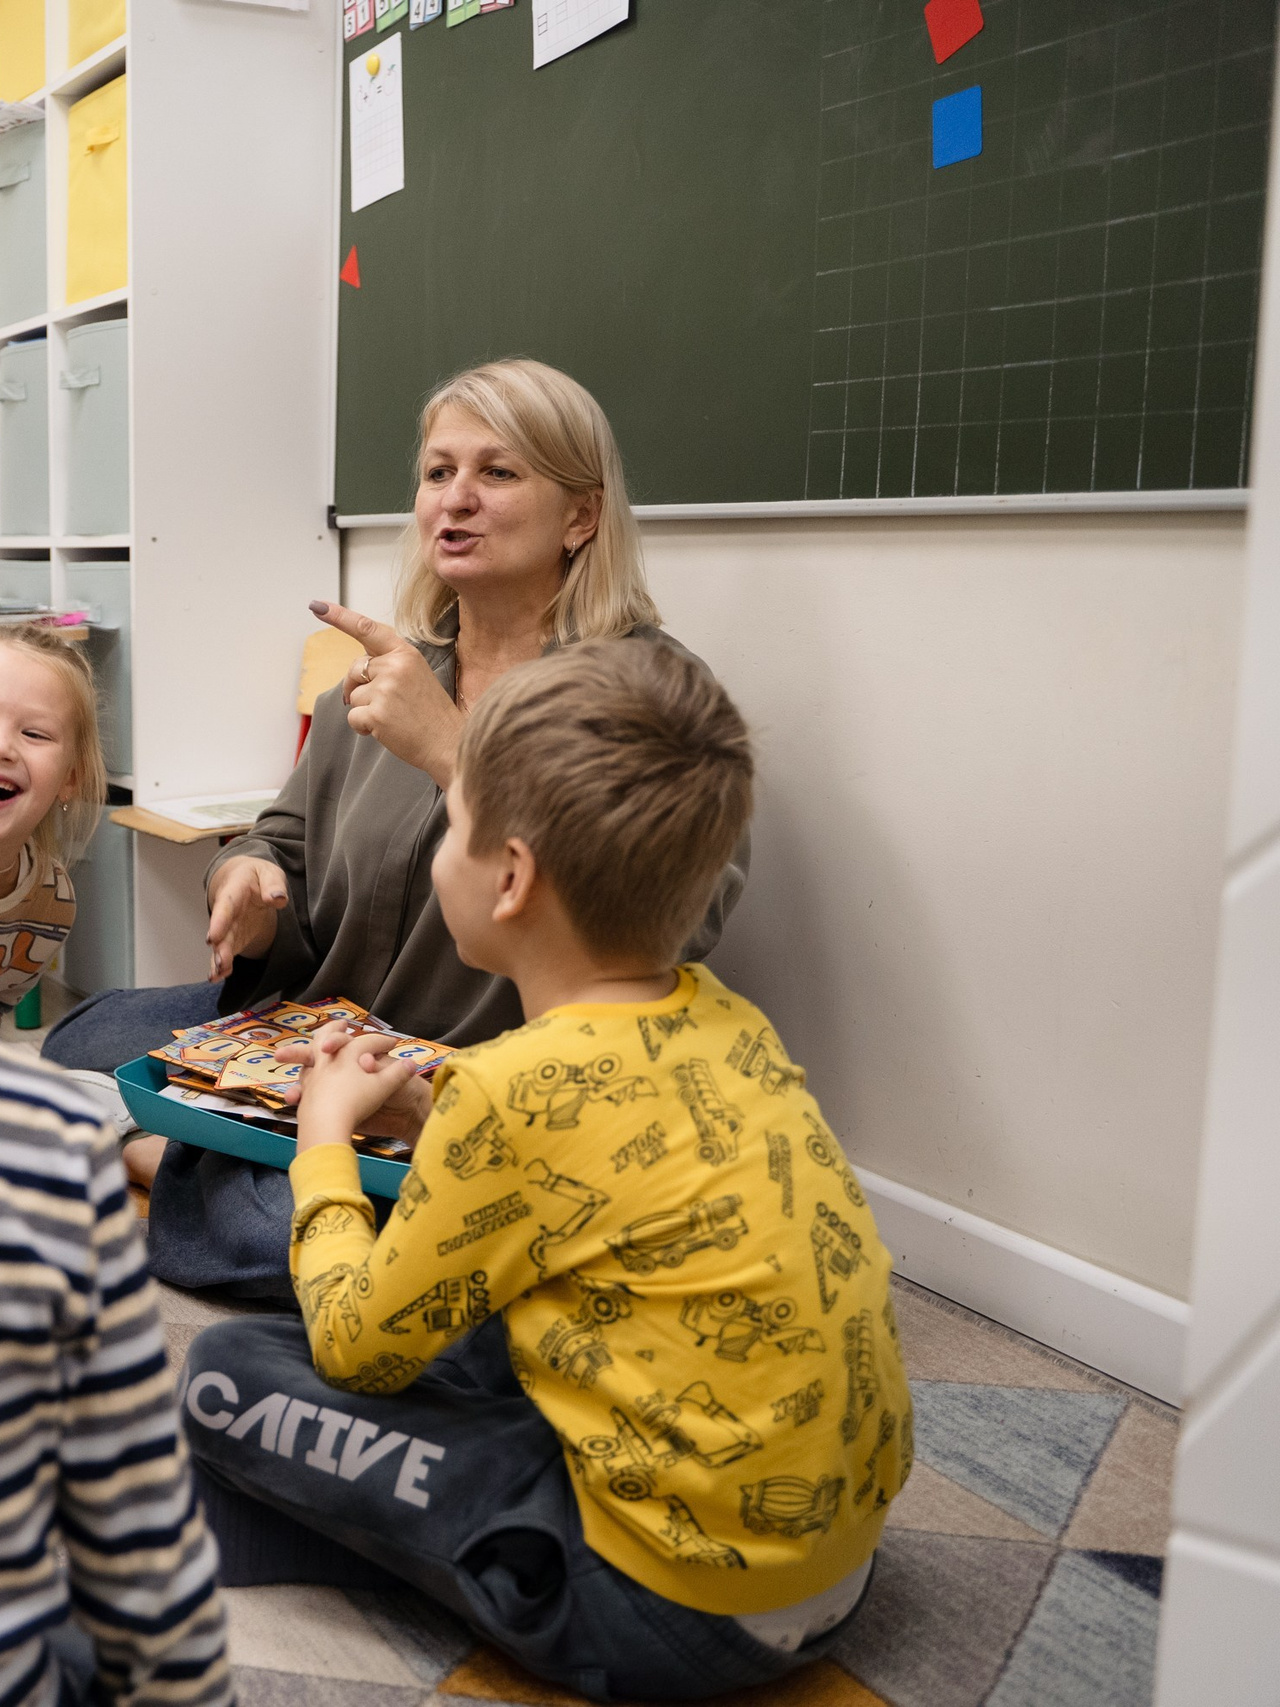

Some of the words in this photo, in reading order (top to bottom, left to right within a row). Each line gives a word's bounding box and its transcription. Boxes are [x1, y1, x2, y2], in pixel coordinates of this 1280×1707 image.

[414, 1, 421, 19] 4
[348, 16, 355, 33] 5
[282, 1014, 308, 1025] 3
[209, 1043, 233, 1052] 1
[398, 1046, 427, 1058] 2
[246, 1053, 275, 1065] 2
